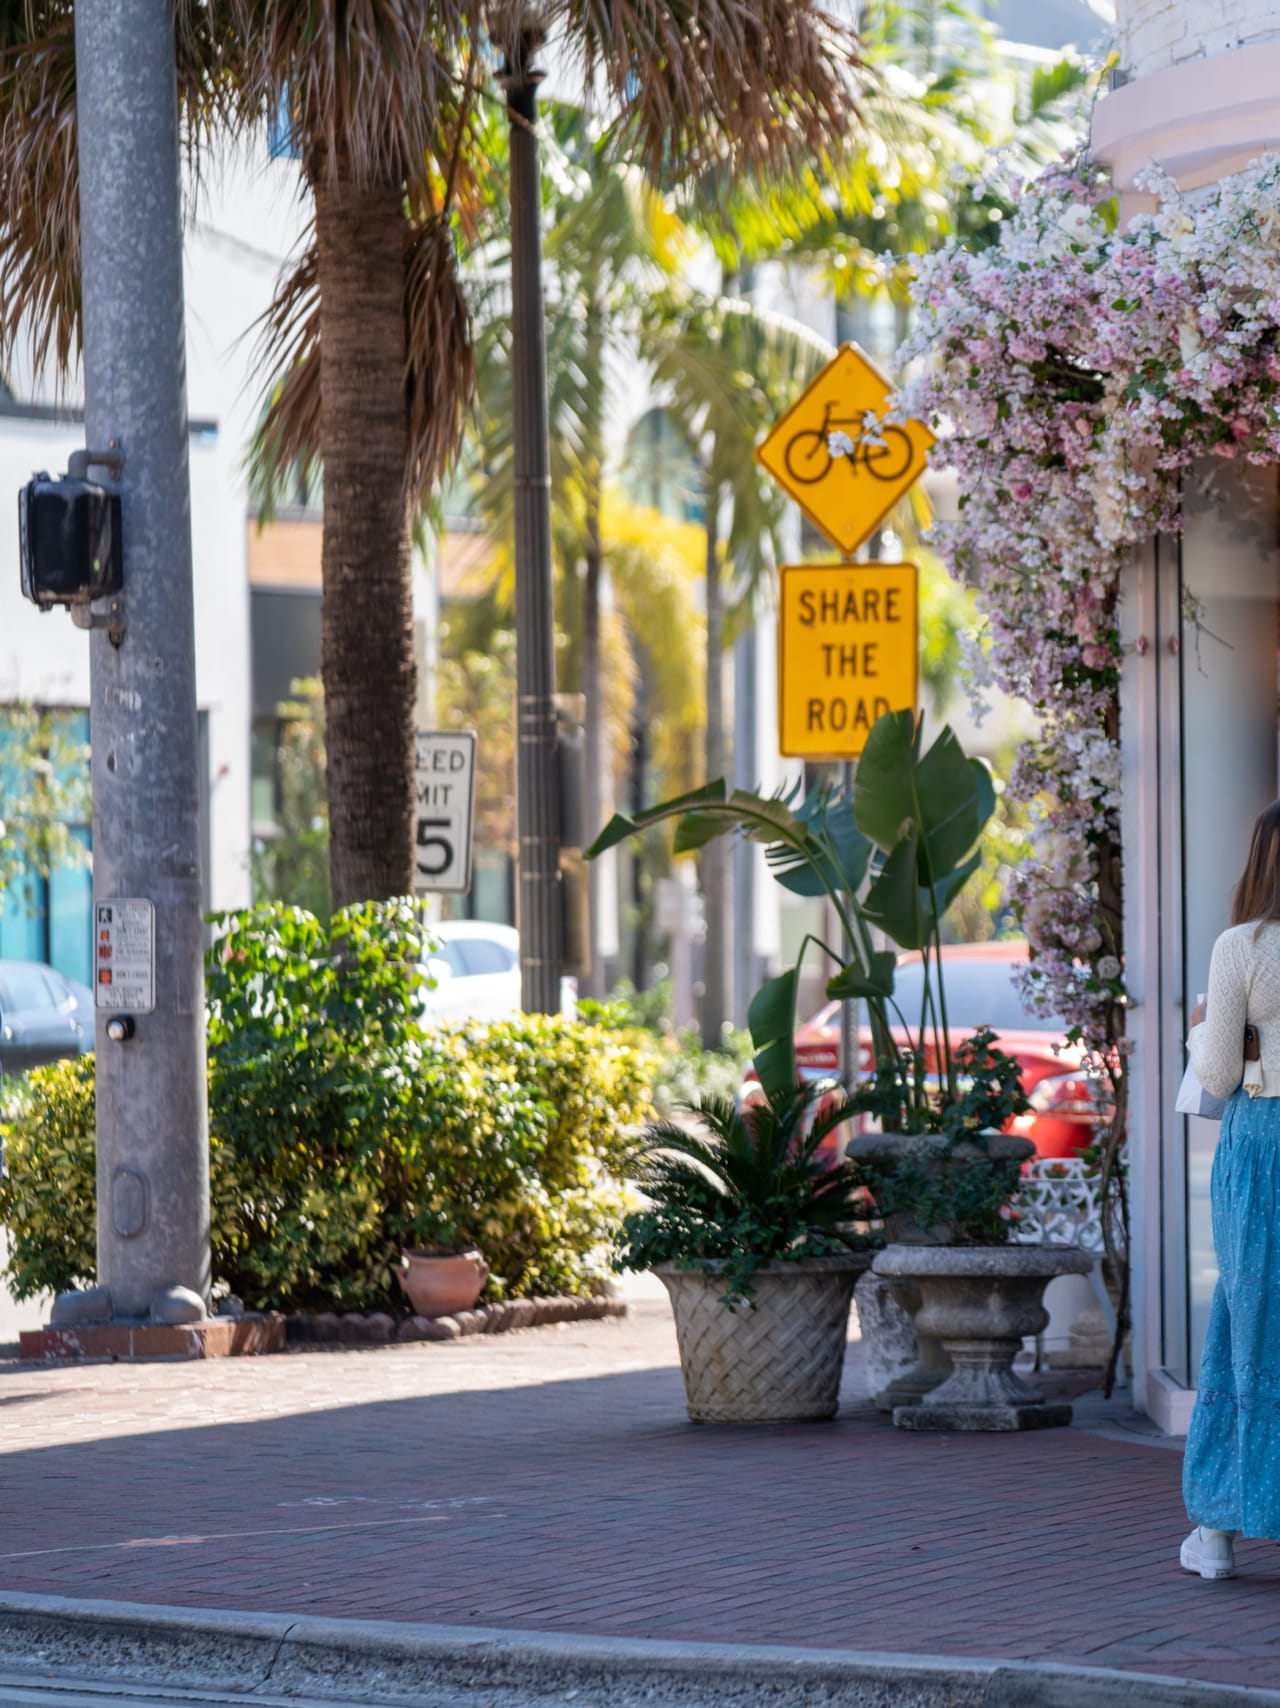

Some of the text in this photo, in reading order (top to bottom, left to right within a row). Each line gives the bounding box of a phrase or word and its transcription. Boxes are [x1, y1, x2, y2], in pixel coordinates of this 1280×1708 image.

[799, 588, 902, 625] SHARE
[821, 643, 879, 678] THE
[415, 750, 465, 772] EED
[416, 783, 453, 806] MIT
[416, 818, 455, 876] 5
